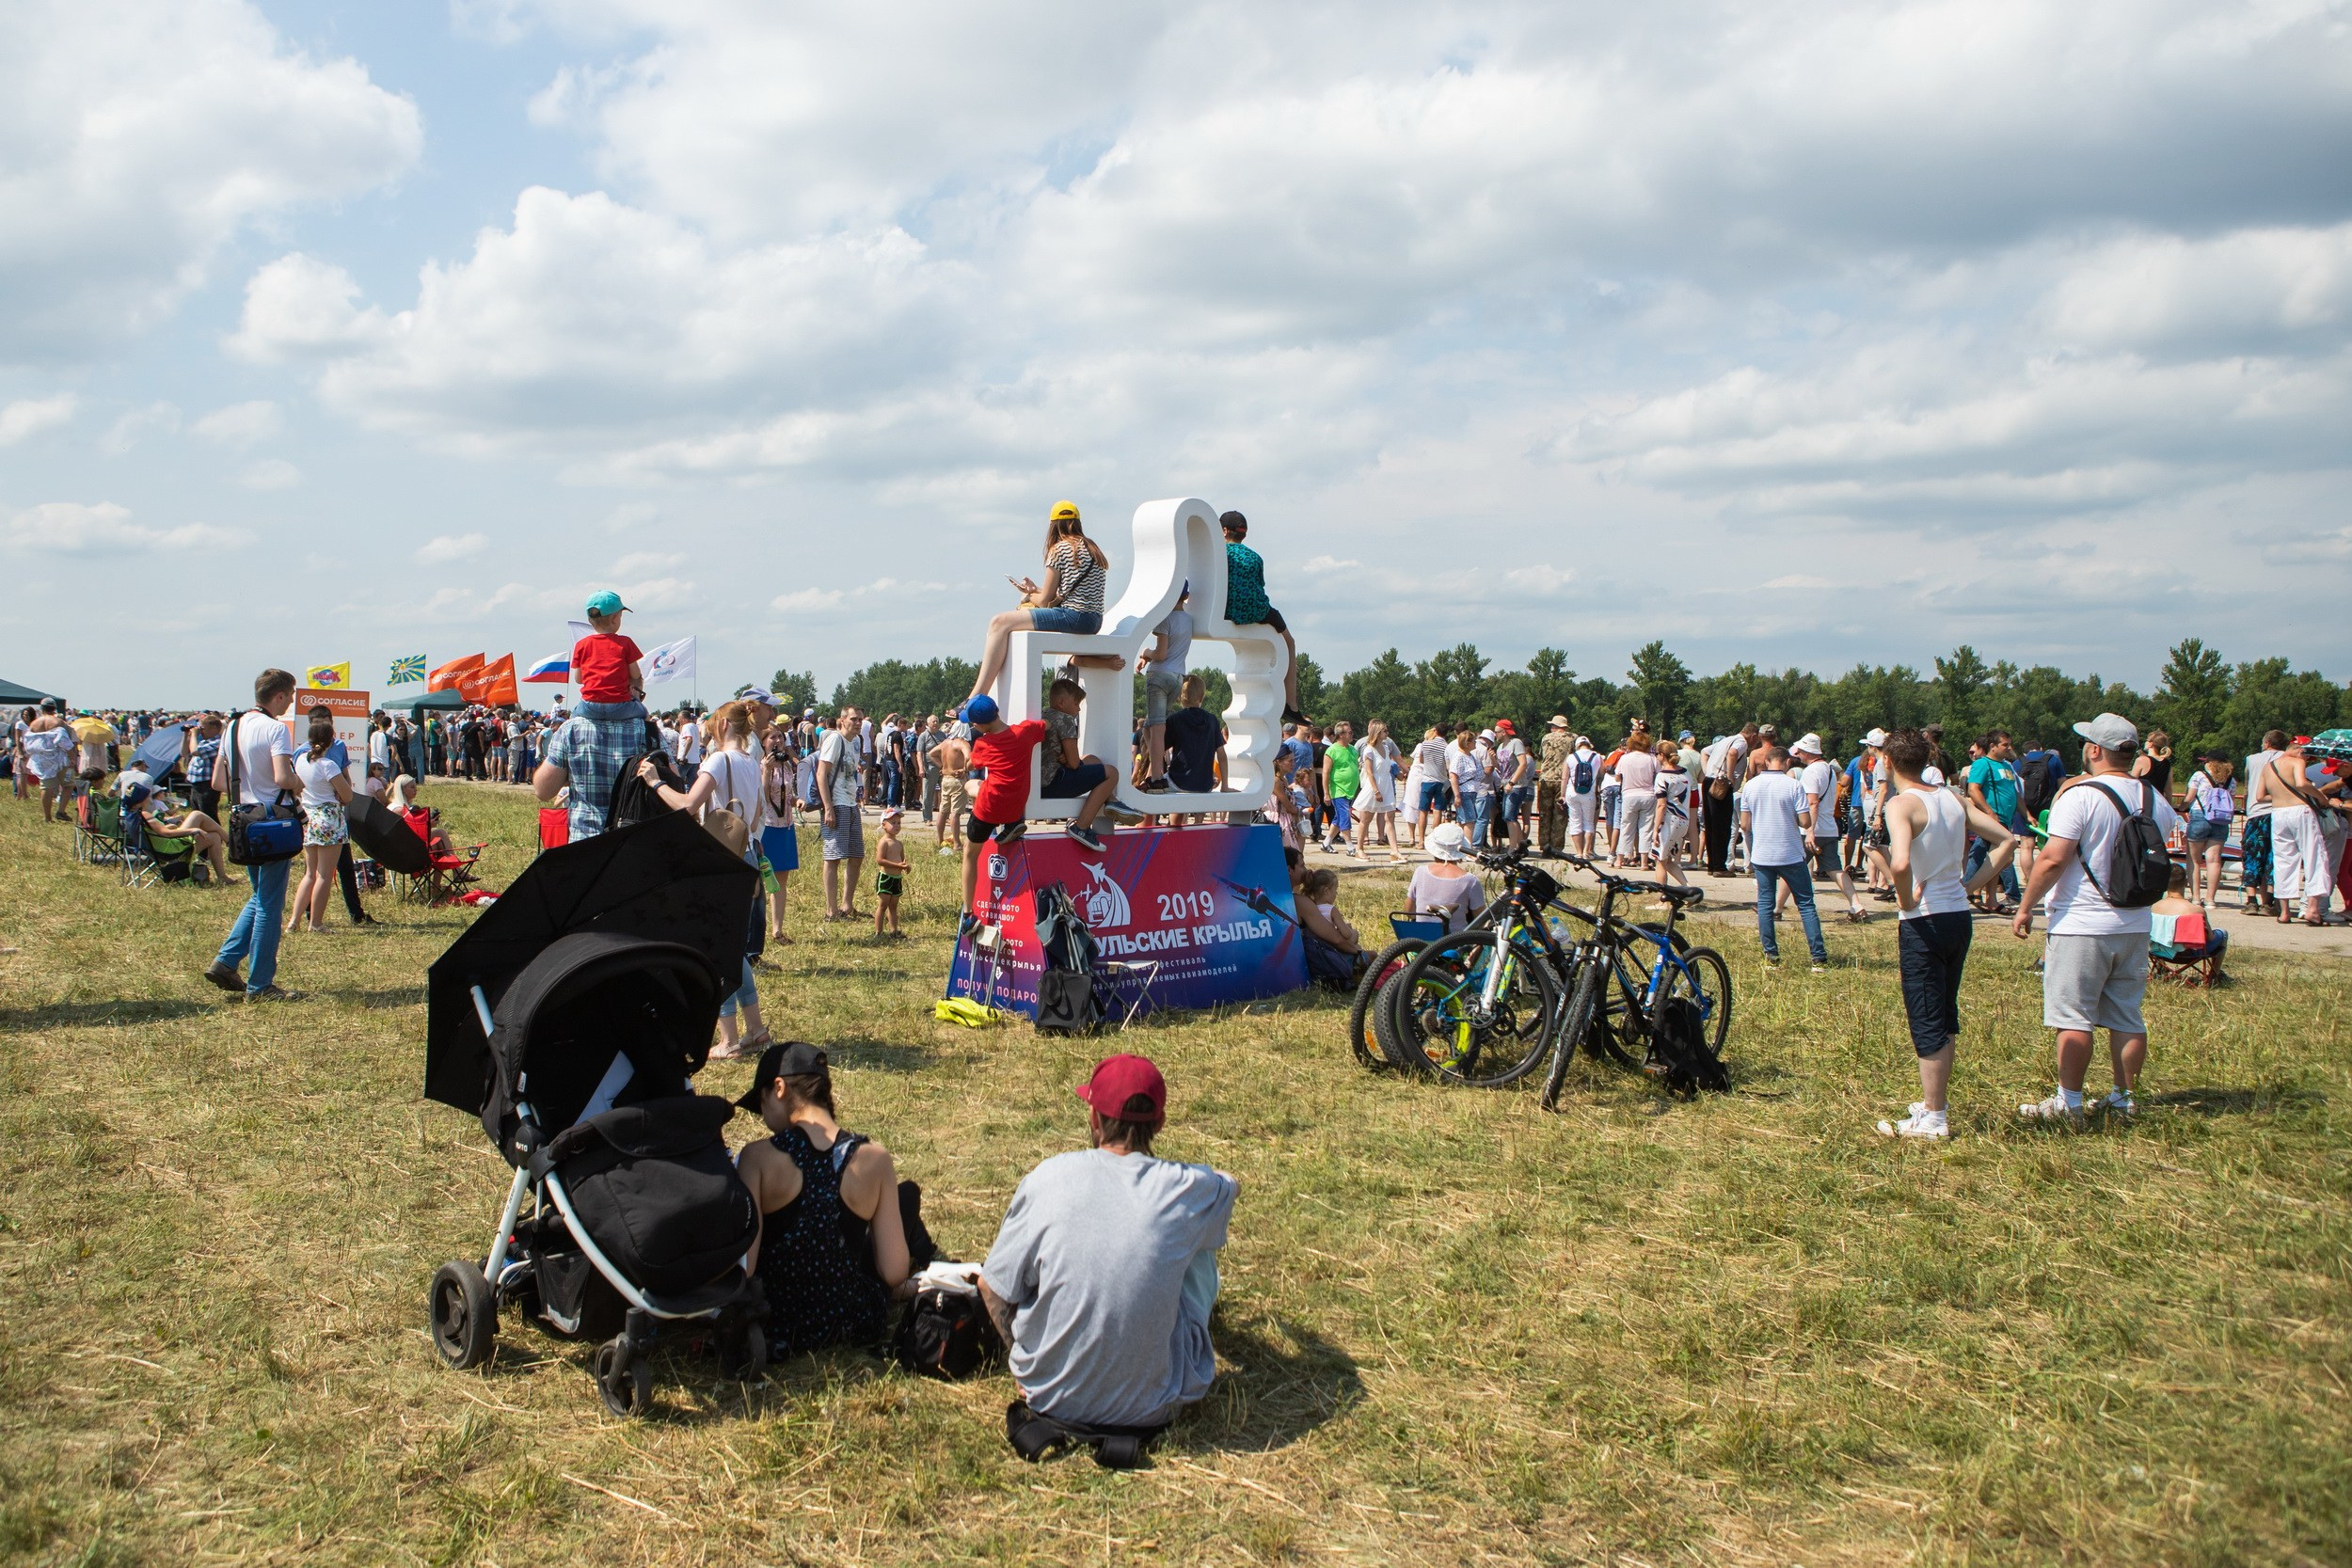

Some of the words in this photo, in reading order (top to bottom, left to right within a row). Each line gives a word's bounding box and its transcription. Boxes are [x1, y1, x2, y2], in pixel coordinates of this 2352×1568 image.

[317, 697, 366, 706] СОГЛАСИЕ
[977, 900, 1001, 910] СДЕЛАЙ
[1001, 904, 1020, 912] ФОТО
[1156, 890, 1215, 922] 2019
[1094, 927, 1190, 958] УЛЬСКИЕ
[1192, 919, 1273, 946] КРЫЛЬЯ
[983, 944, 1016, 957] ХЭШЕГОМ
[959, 949, 1041, 972] #туьскекрылья
[1159, 957, 1206, 971] фестиваль
[1182, 963, 1238, 979] авиамоделей
[957, 977, 994, 995] ПОУЧ
[996, 986, 1038, 1004] ПОДАРО
